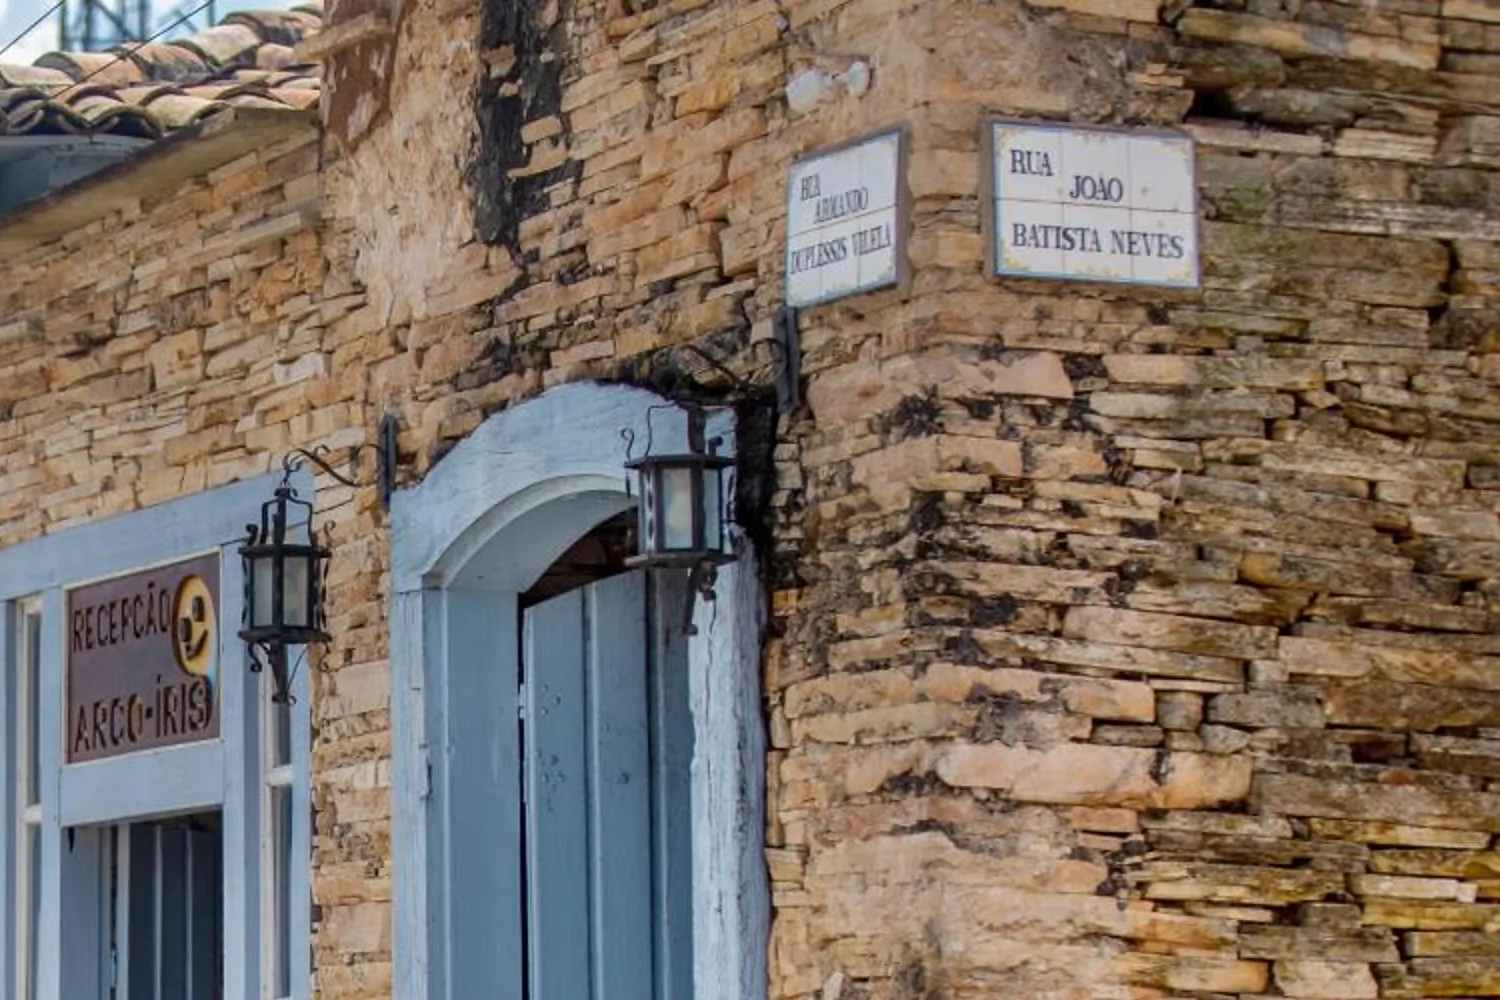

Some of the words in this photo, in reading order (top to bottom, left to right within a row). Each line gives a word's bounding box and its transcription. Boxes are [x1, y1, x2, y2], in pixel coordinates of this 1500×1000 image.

[1010, 149, 1054, 177] RUA
[1012, 222, 1102, 253] BATISTA
[1110, 228, 1185, 259] NEVES
